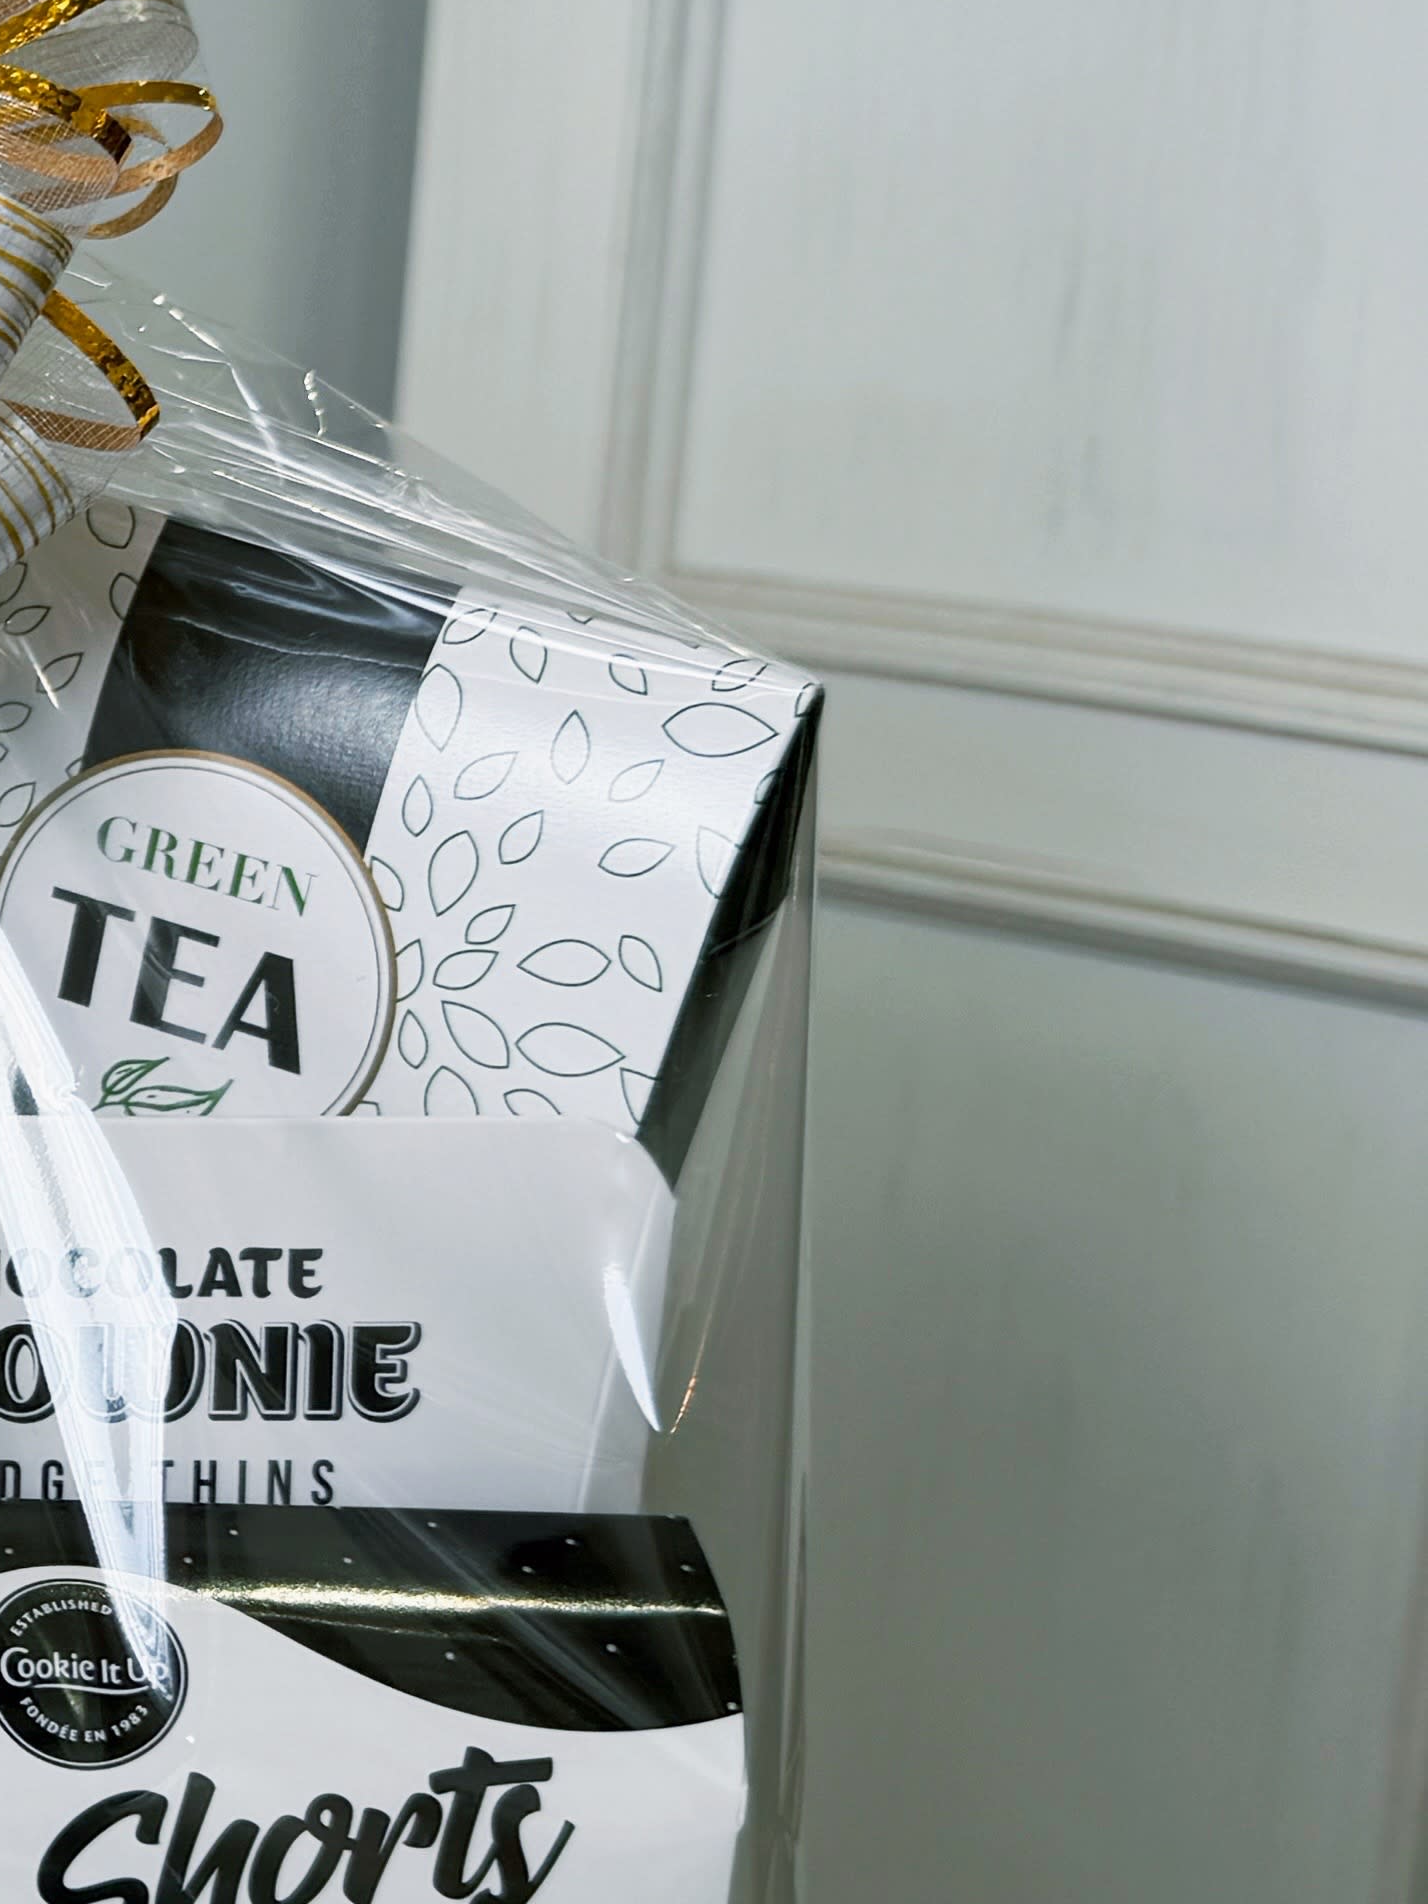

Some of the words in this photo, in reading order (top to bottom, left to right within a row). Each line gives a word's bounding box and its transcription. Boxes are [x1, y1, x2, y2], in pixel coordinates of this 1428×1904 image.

[96, 815, 320, 917] GREEN
[50, 886, 302, 1075] TEA
[152, 1459, 335, 1506] THINS
[9, 1598, 113, 1638] ESTABLISHED
[0, 1646, 95, 1688] Cookie
[100, 1658, 123, 1685] It
[19, 1696, 79, 1742] FONDÉE
[83, 1729, 107, 1743] EN
[110, 1704, 149, 1737] 1983
